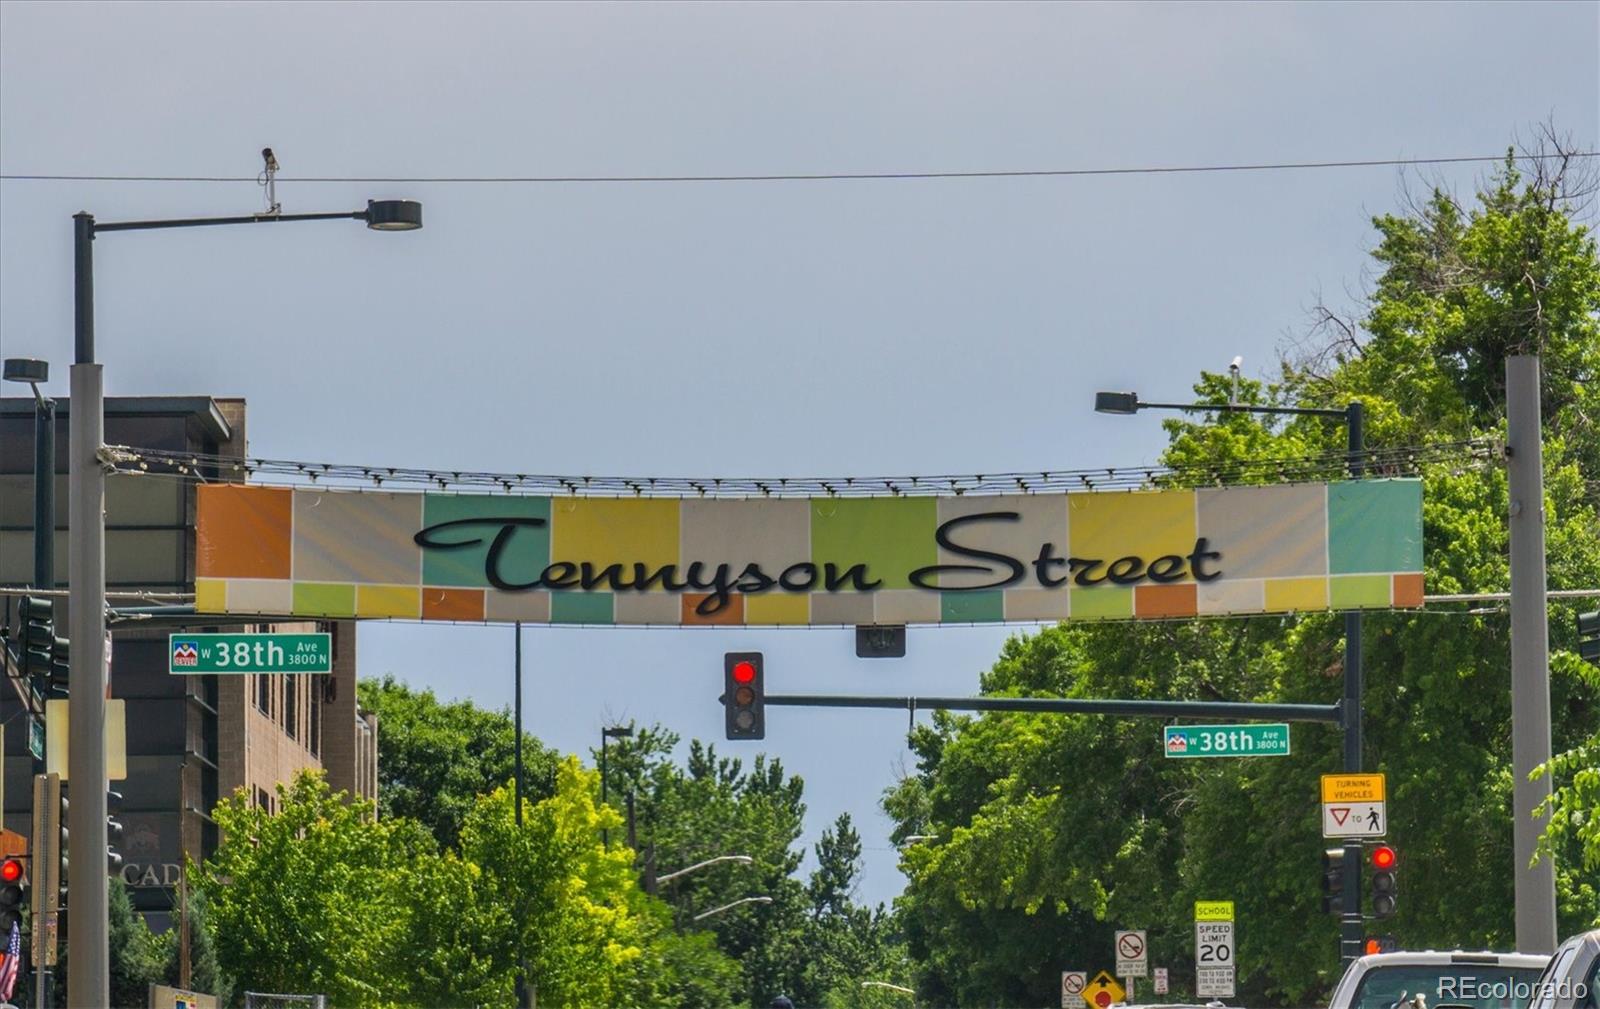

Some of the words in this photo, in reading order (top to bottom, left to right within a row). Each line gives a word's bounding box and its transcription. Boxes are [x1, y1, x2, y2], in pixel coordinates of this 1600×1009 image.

[413, 516, 882, 616] Tennyson
[908, 511, 1222, 591] Street
[201, 648, 211, 659] W
[215, 641, 284, 666] 38th
[296, 642, 317, 652] Ave
[288, 654, 316, 665] 3800
[319, 653, 327, 664] N
[1189, 737, 1197, 745] W
[1200, 730, 1253, 752] 38th
[1262, 731, 1279, 739] Ave
[1256, 740, 1278, 750] 3800
[1279, 740, 1286, 749] N
[1336, 779, 1371, 788] TURNING
[1334, 790, 1374, 799] VEHICLES
[1351, 815, 1362, 823] TO
[1198, 906, 1231, 916] SCHOOL
[1199, 925, 1231, 934] SPEED
[1202, 934, 1227, 943] LIMIT
[1200, 944, 1230, 962] 20
